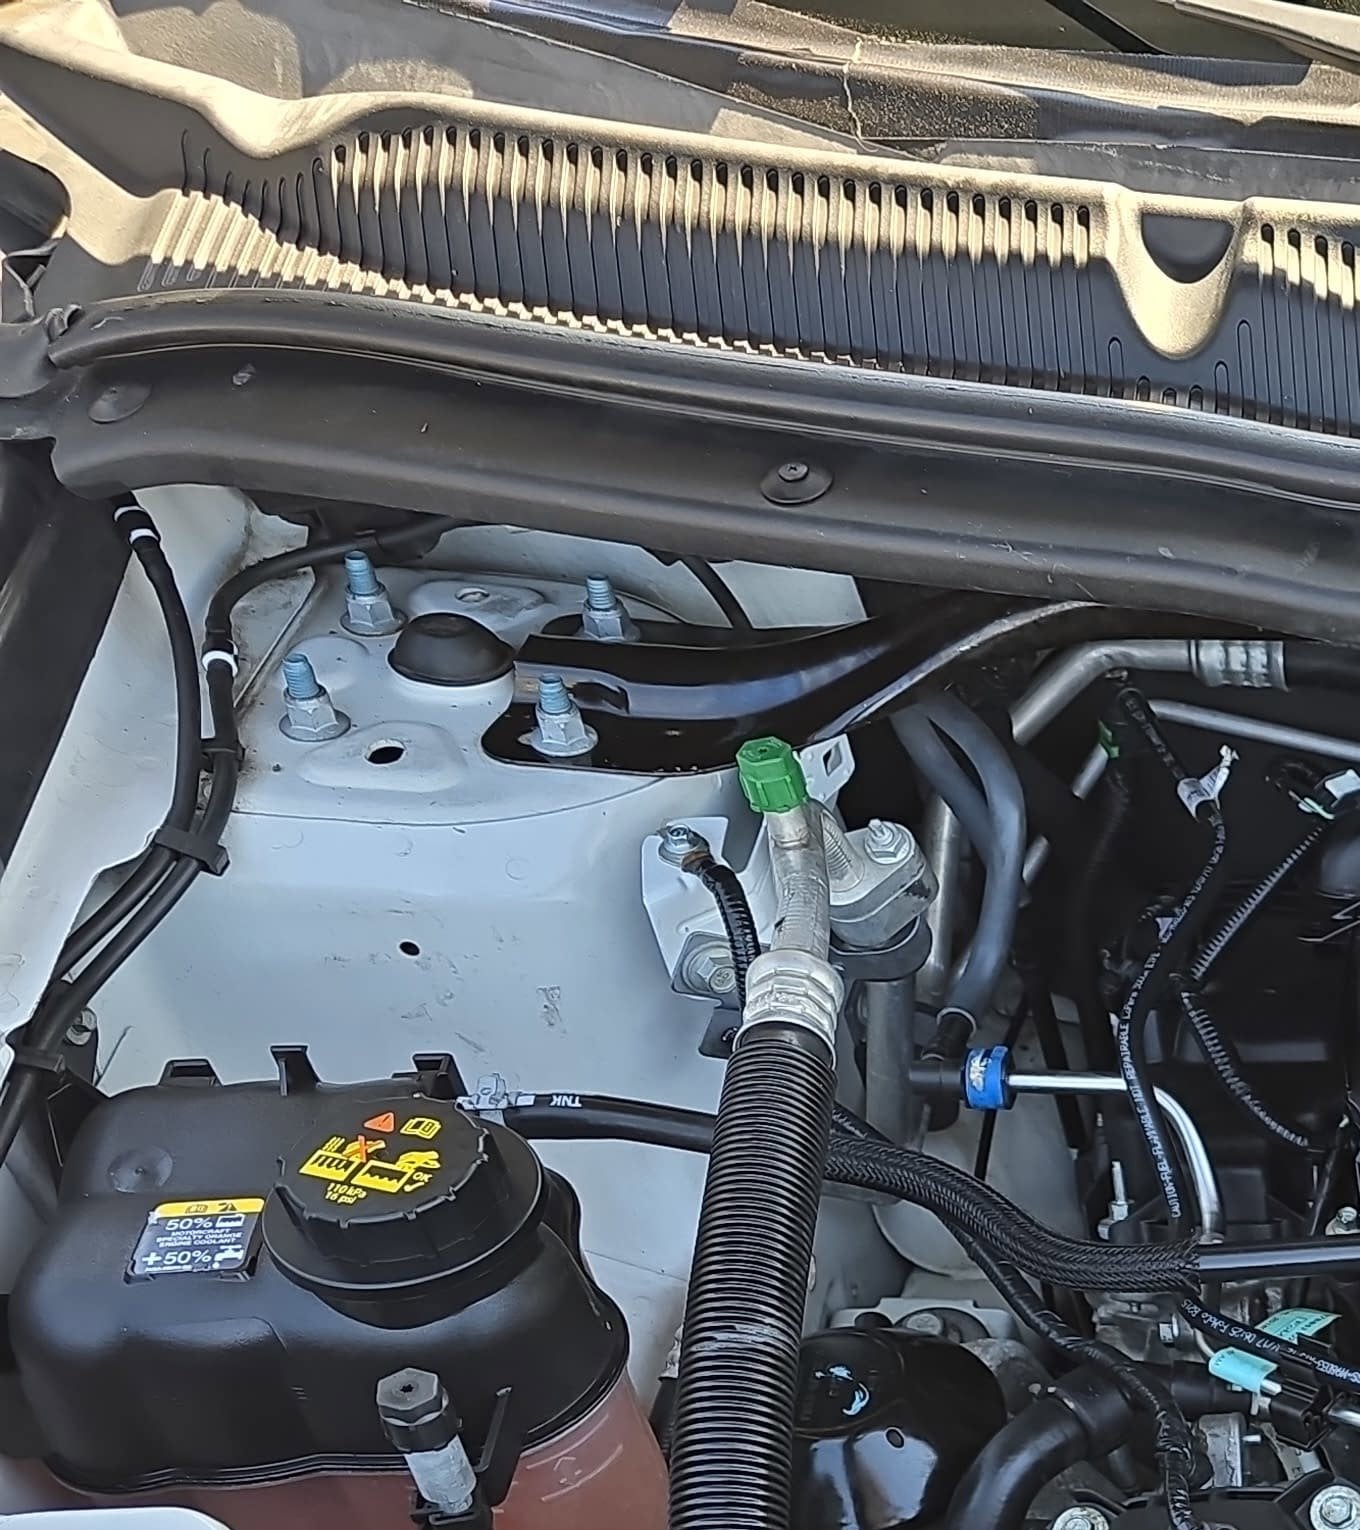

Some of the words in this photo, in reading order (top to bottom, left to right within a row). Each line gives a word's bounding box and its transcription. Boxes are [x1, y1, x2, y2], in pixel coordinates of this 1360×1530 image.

[549, 1095, 582, 1107] TNK
[413, 1172, 433, 1182] OK
[328, 1183, 346, 1194] 110
[348, 1186, 367, 1199] kPa
[165, 1217, 213, 1231] 50%
